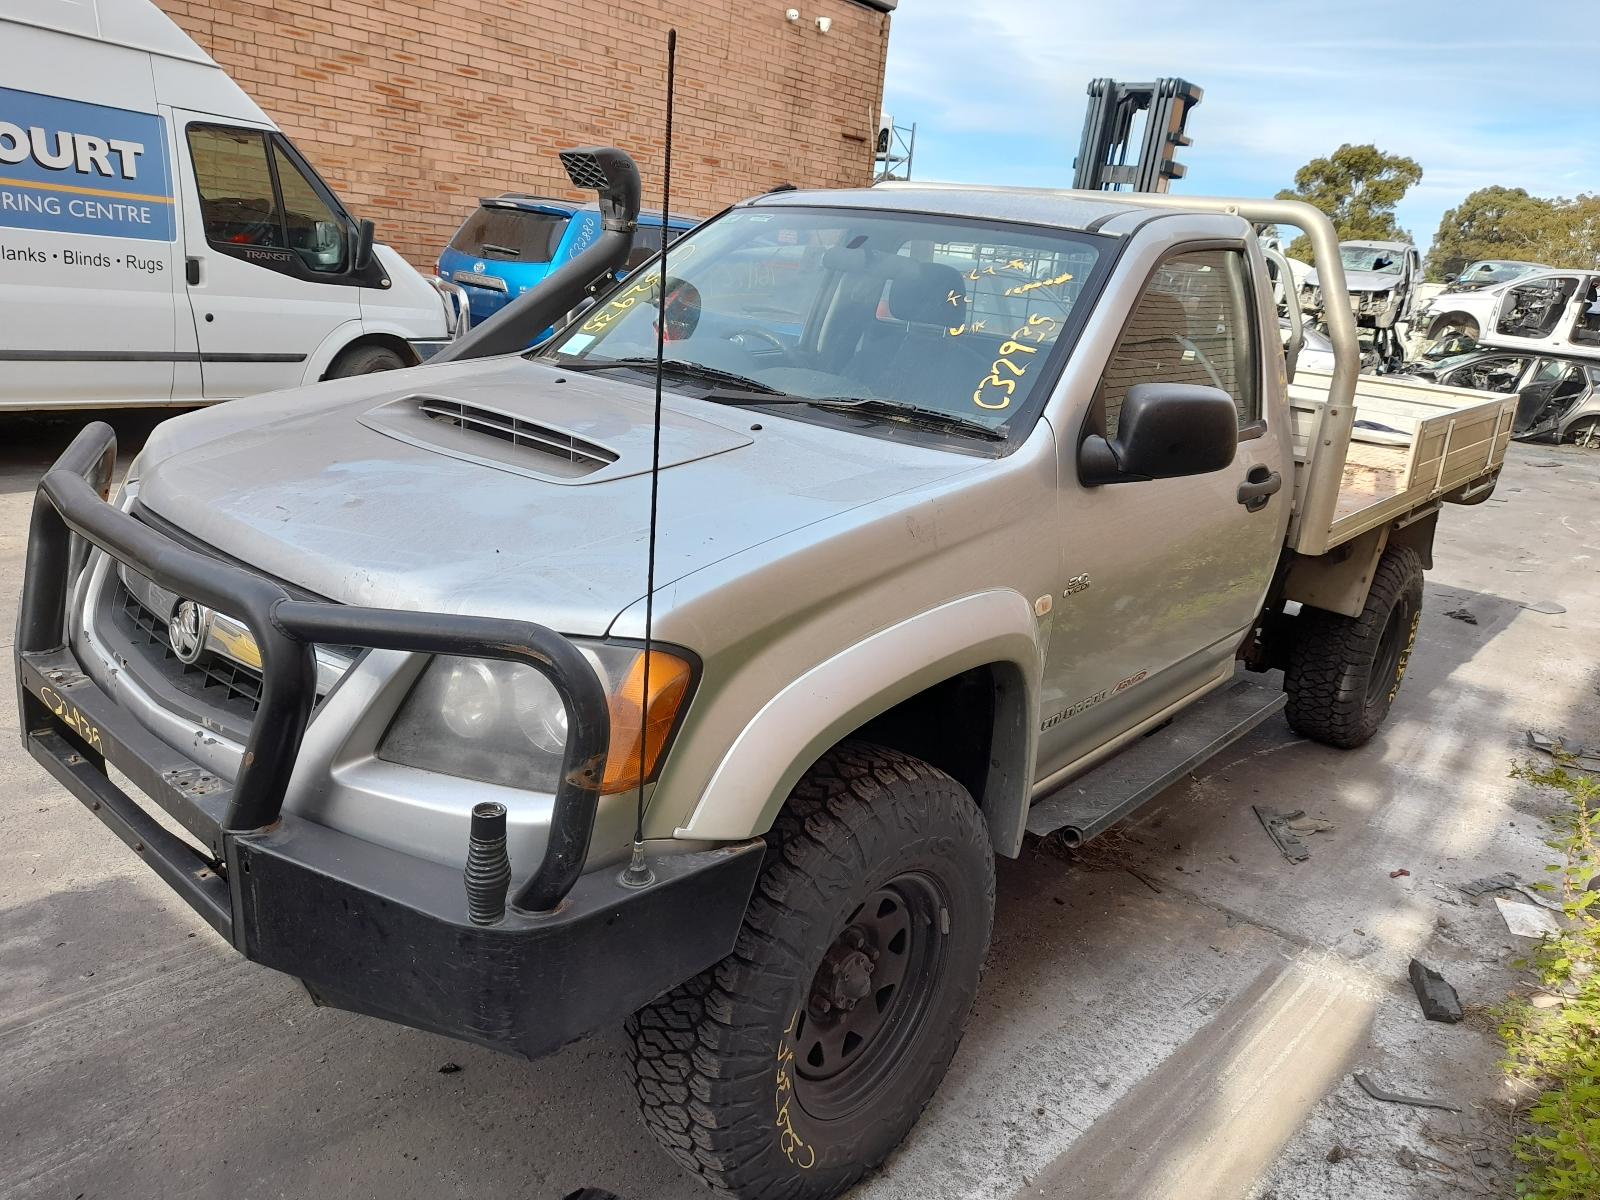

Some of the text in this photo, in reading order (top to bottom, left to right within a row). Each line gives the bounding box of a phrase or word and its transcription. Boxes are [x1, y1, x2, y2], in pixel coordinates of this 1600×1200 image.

[1, 191, 152, 224] RING CENTRE
[0, 244, 164, 274] lanks Blinds Rugs
[244, 250, 292, 262] TRANSIT
[973, 313, 1056, 409] C32935
